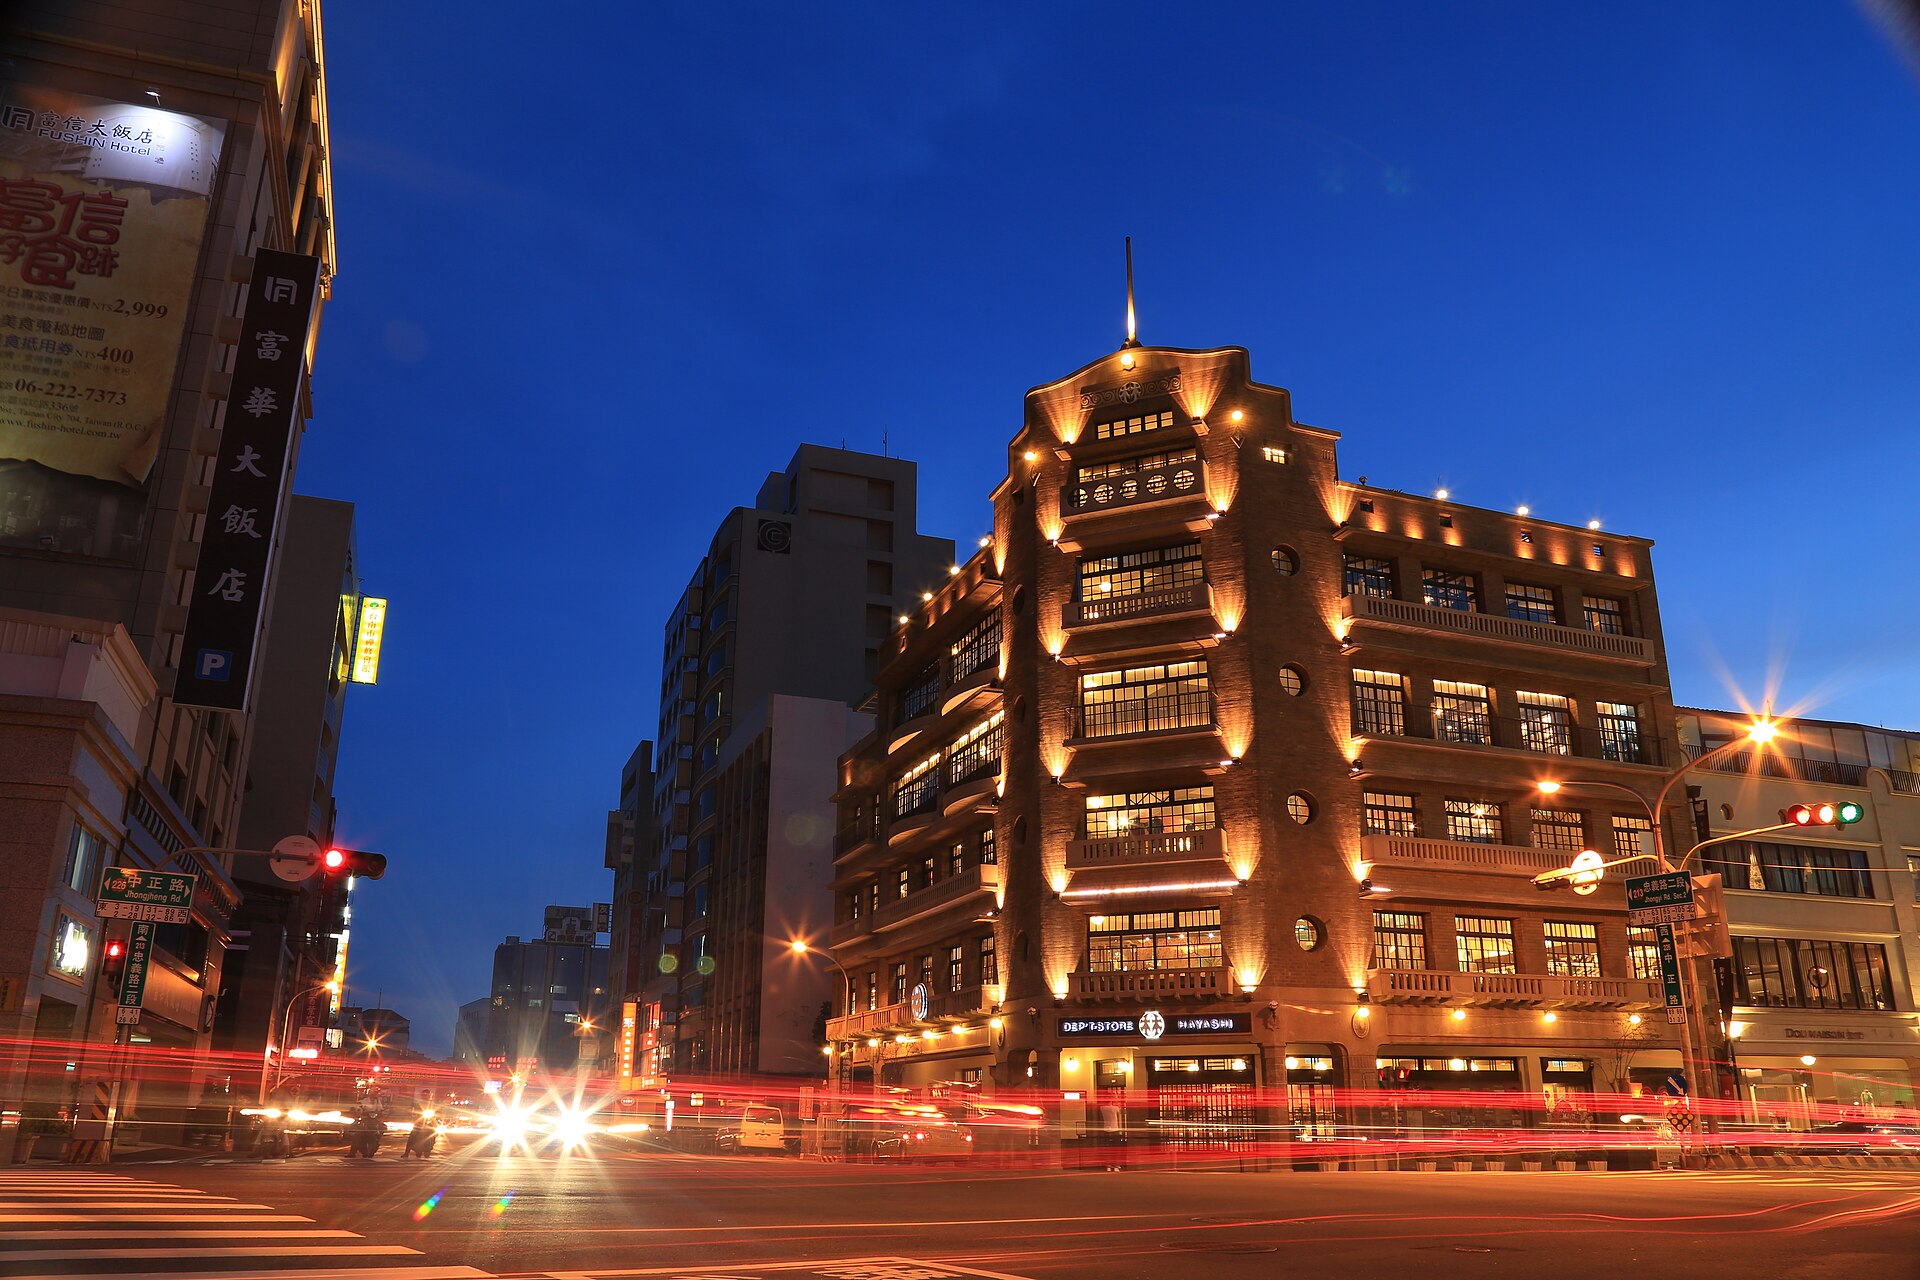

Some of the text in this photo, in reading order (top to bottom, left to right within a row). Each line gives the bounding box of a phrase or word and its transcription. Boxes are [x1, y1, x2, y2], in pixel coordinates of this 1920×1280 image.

[40, 110, 153, 144] 富信大飯店
[38, 128, 107, 148] FUSHIN
[110, 141, 151, 156] Hotel
[15, 378, 127, 406] 06-222-7373
[209, 330, 289, 603] 富華大飯店
[202, 653, 225, 676] P
[128, 875, 184, 892] 中正路
[1633, 889, 1643, 898] 213
[1643, 877, 1685, 893] 忠義路二段
[125, 891, 182, 903] Jhongjheng Rd.
[137, 925, 148, 935] 南
[126, 951, 144, 1005] 忠義路二段
[1664, 953, 1679, 1005] 中正路
[1177, 1018, 1234, 1030] HAYASHI
